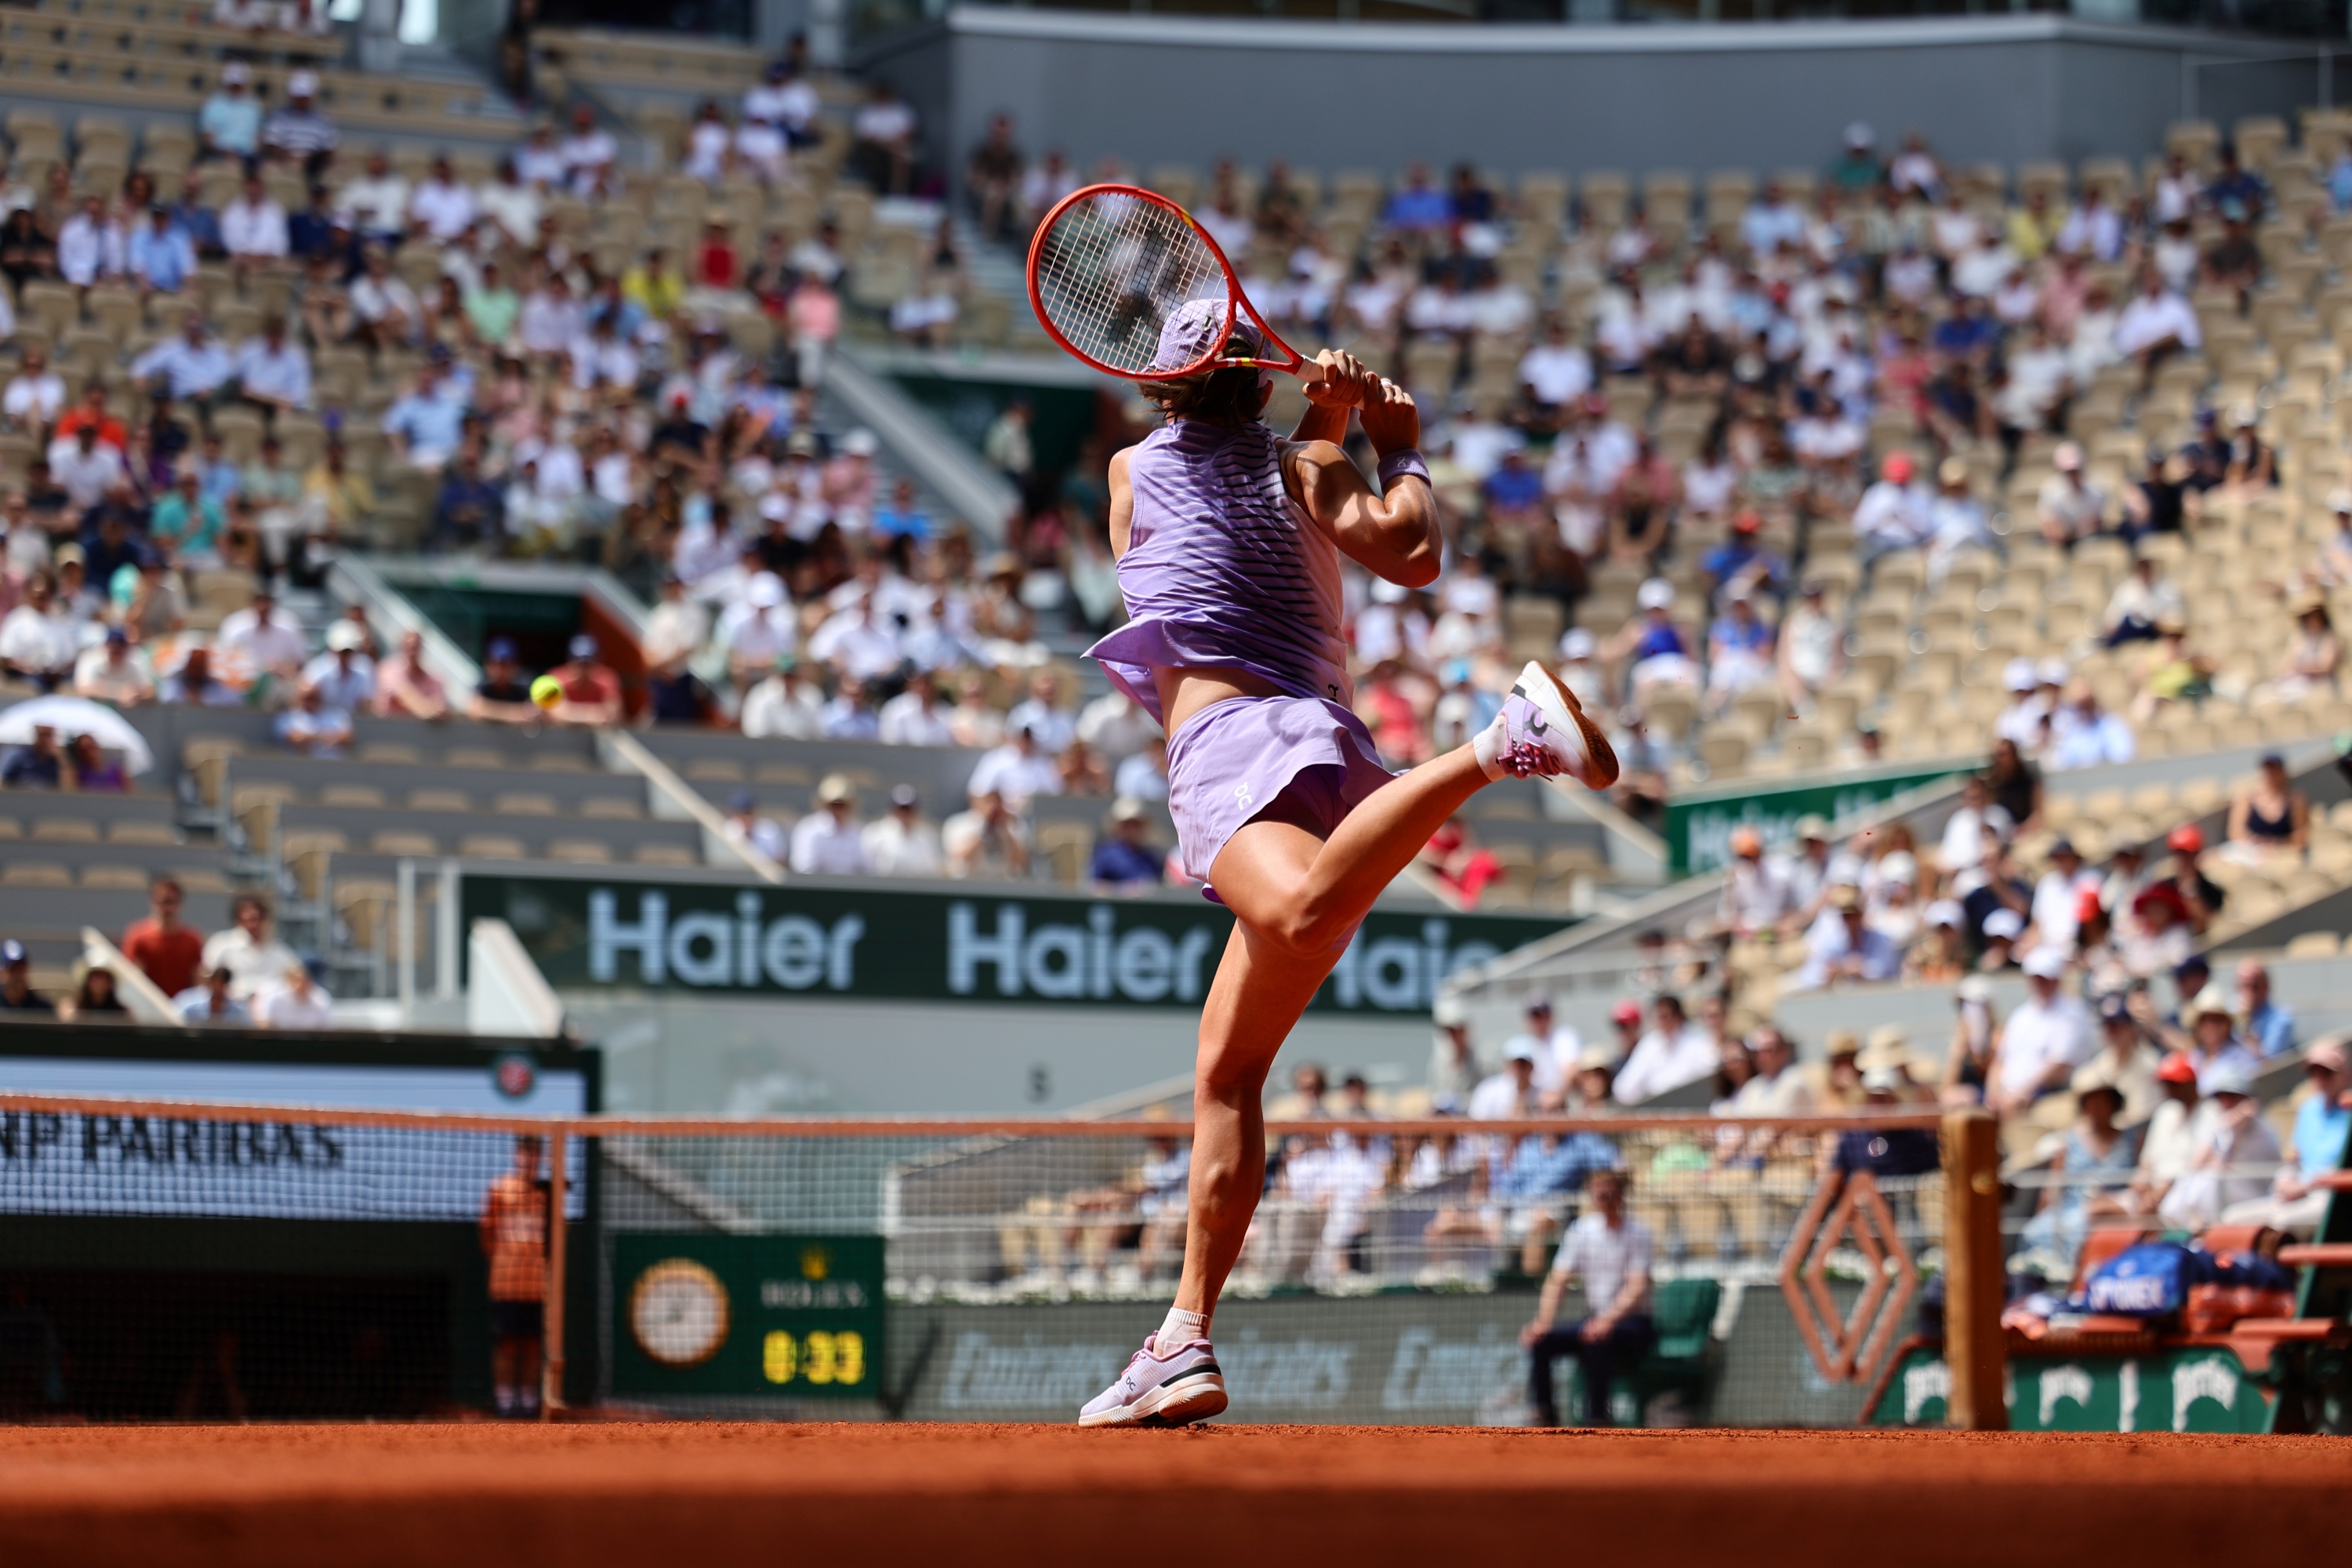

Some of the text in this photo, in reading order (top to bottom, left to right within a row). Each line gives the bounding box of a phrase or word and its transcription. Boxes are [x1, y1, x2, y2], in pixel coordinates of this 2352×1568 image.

[588, 890, 864, 989] Haier
[948, 903, 1212, 1001] Haier
[81, 1112, 345, 1169] PARIBAS
